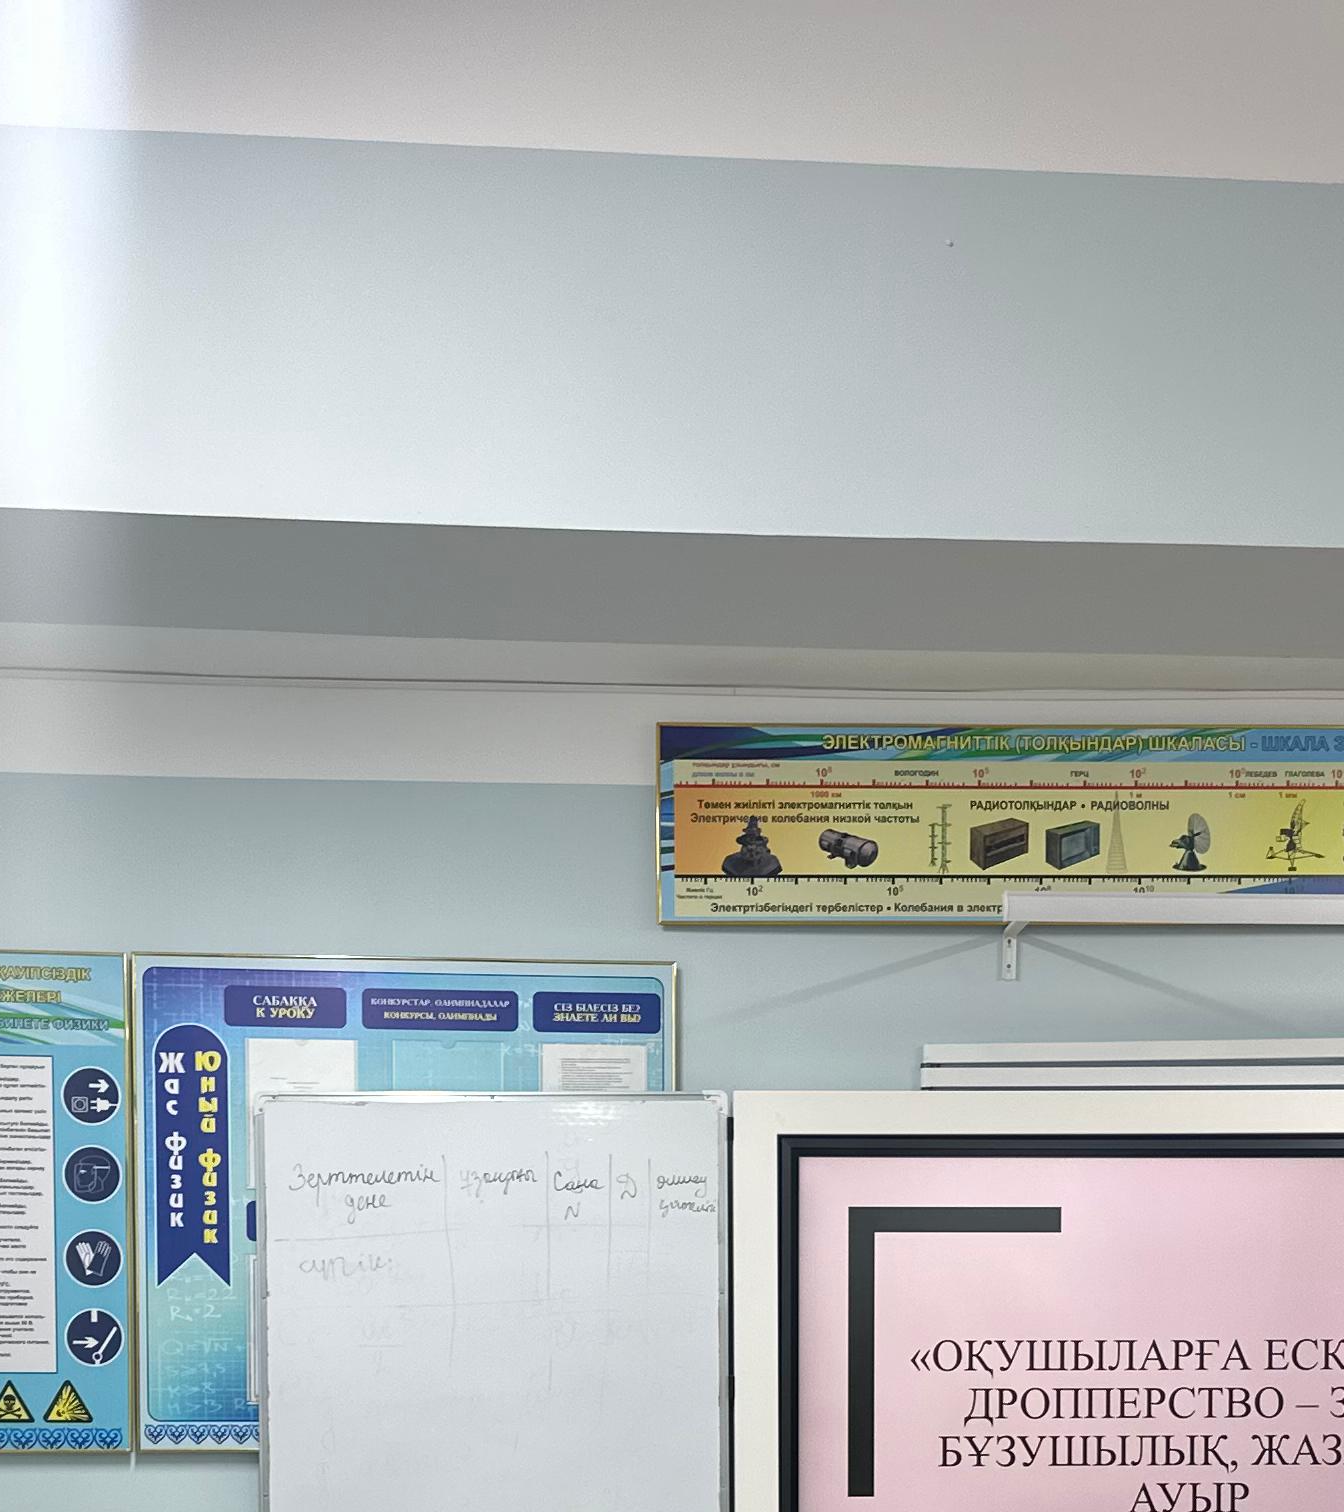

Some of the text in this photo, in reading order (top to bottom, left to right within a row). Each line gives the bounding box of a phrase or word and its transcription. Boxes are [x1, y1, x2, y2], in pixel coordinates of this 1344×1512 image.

[821, 734, 1009, 751] ЭЛЕКТРОМАГНИТТІК
[1015, 735, 1143, 754] (ТОЛҚЫНДАР)
[1148, 735, 1246, 751] ШКАЛАСЫ
[1261, 735, 1330, 752] ШКАЛА
[778, 800, 871, 812] электромагниттік
[970, 800, 1170, 812] РАДИОТОЛҚЫНДАР РАДИОВОЛНЫ
[772, 813, 829, 824] колебания
[833, 813, 871, 824] низкой
[874, 814, 920, 824] частоты
[894, 902, 954, 913] Колебания
[270, 1007, 315, 1018] УРОКУ
[51, 1018, 109, 1031] ФИЗИКИ
[910, 1338, 1253, 1378] «ОҚУШЫЛАРҒА
[964, 1386, 1285, 1427] ДРОППЕРСТВО
[937, 1433, 1240, 1473] БҰЗУШЫЛЫҚ,
